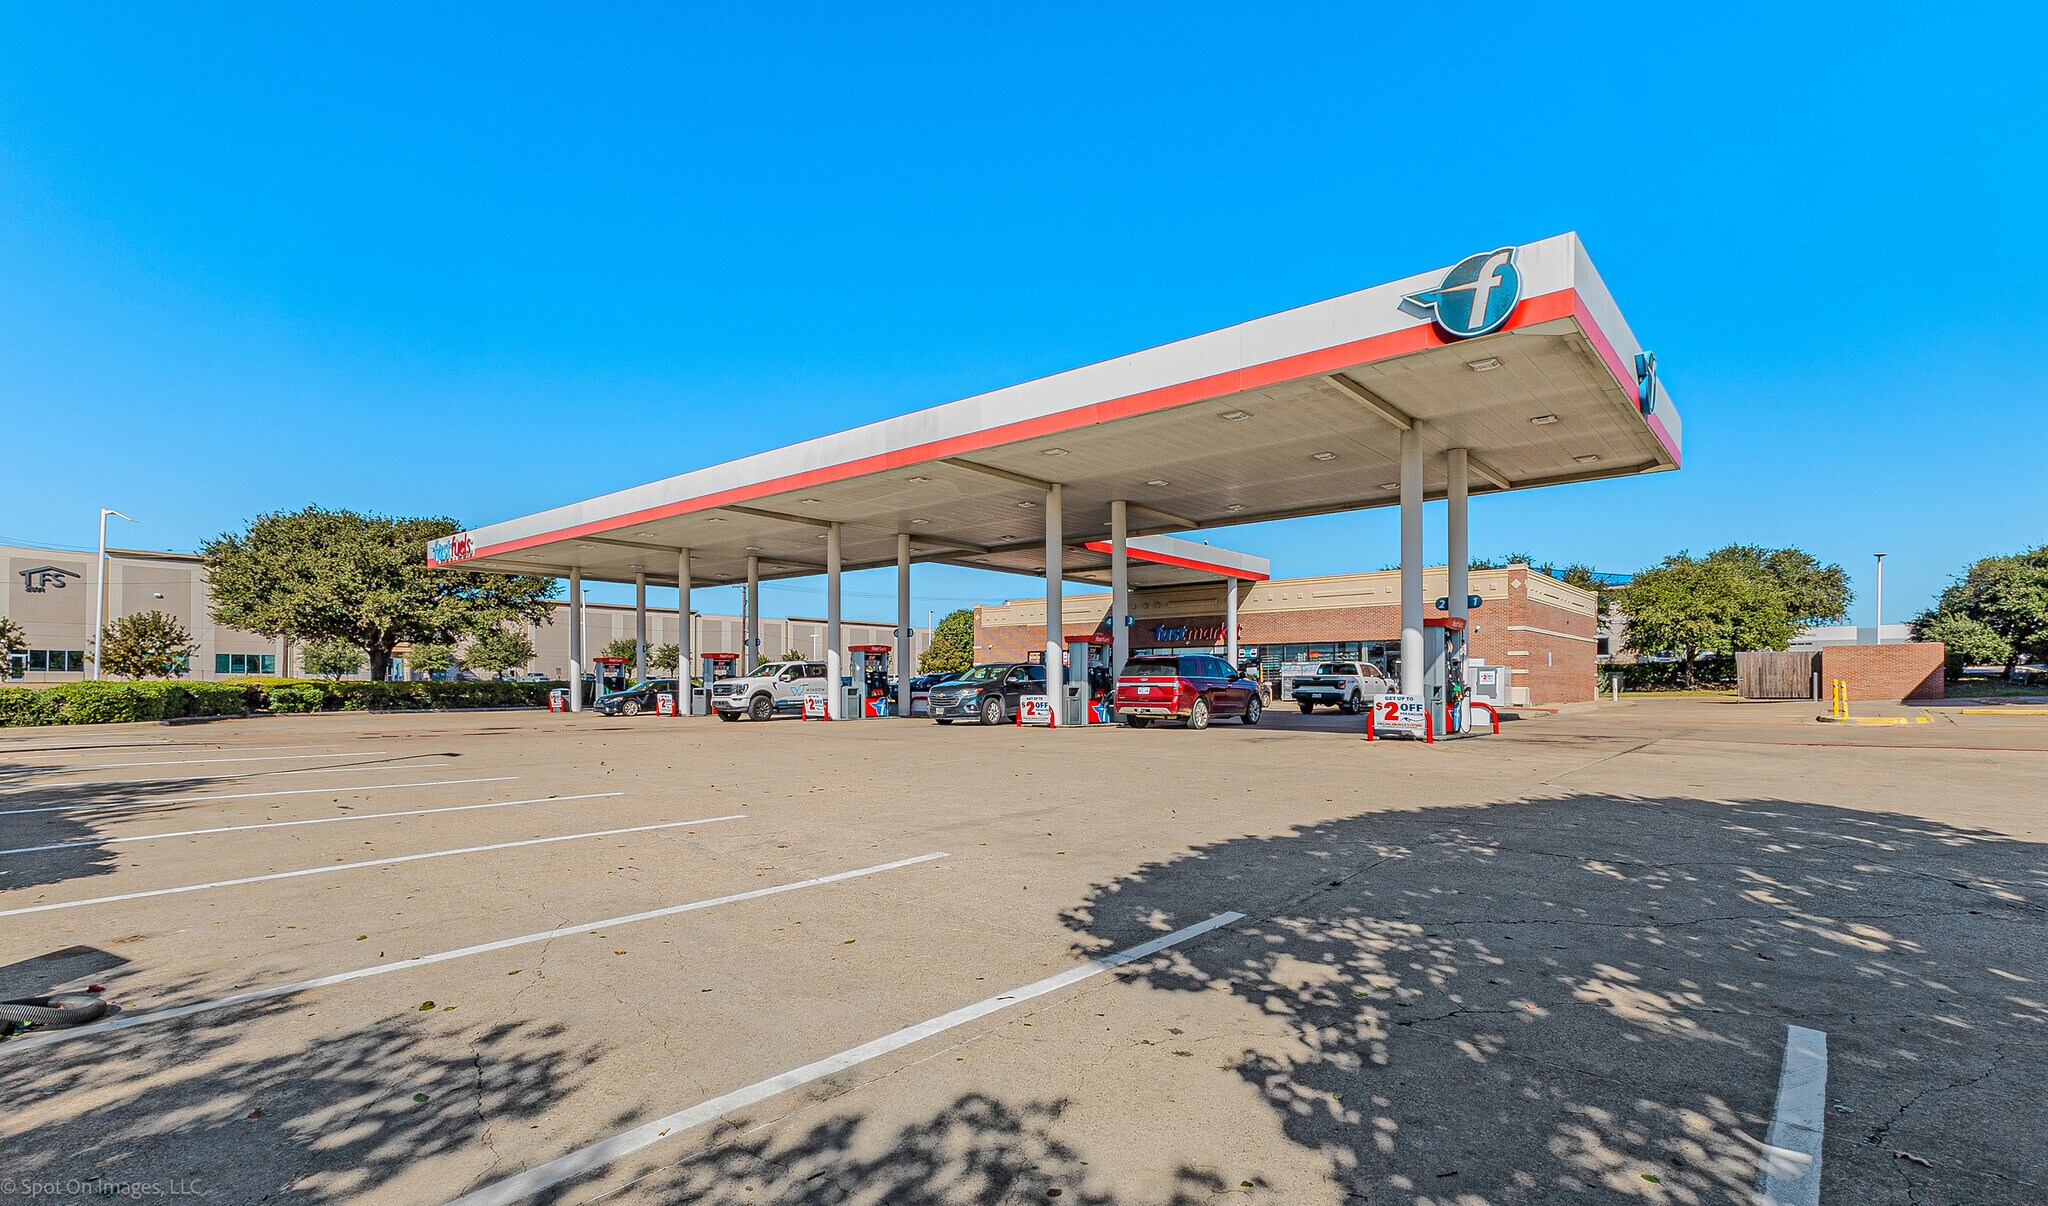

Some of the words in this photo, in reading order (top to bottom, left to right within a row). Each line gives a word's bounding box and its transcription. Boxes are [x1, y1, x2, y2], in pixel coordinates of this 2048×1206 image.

[20, 567, 68, 588] TFS
[1438, 600, 1446, 608] 2
[1473, 597, 1478, 606] 1
[1106, 617, 1112, 625] 4
[1128, 617, 1133, 625] 3
[1153, 622, 1243, 641] fastmarkt
[1021, 701, 1035, 715] $2
[1375, 701, 1399, 721] $2
[1400, 703, 1423, 712] OFF
